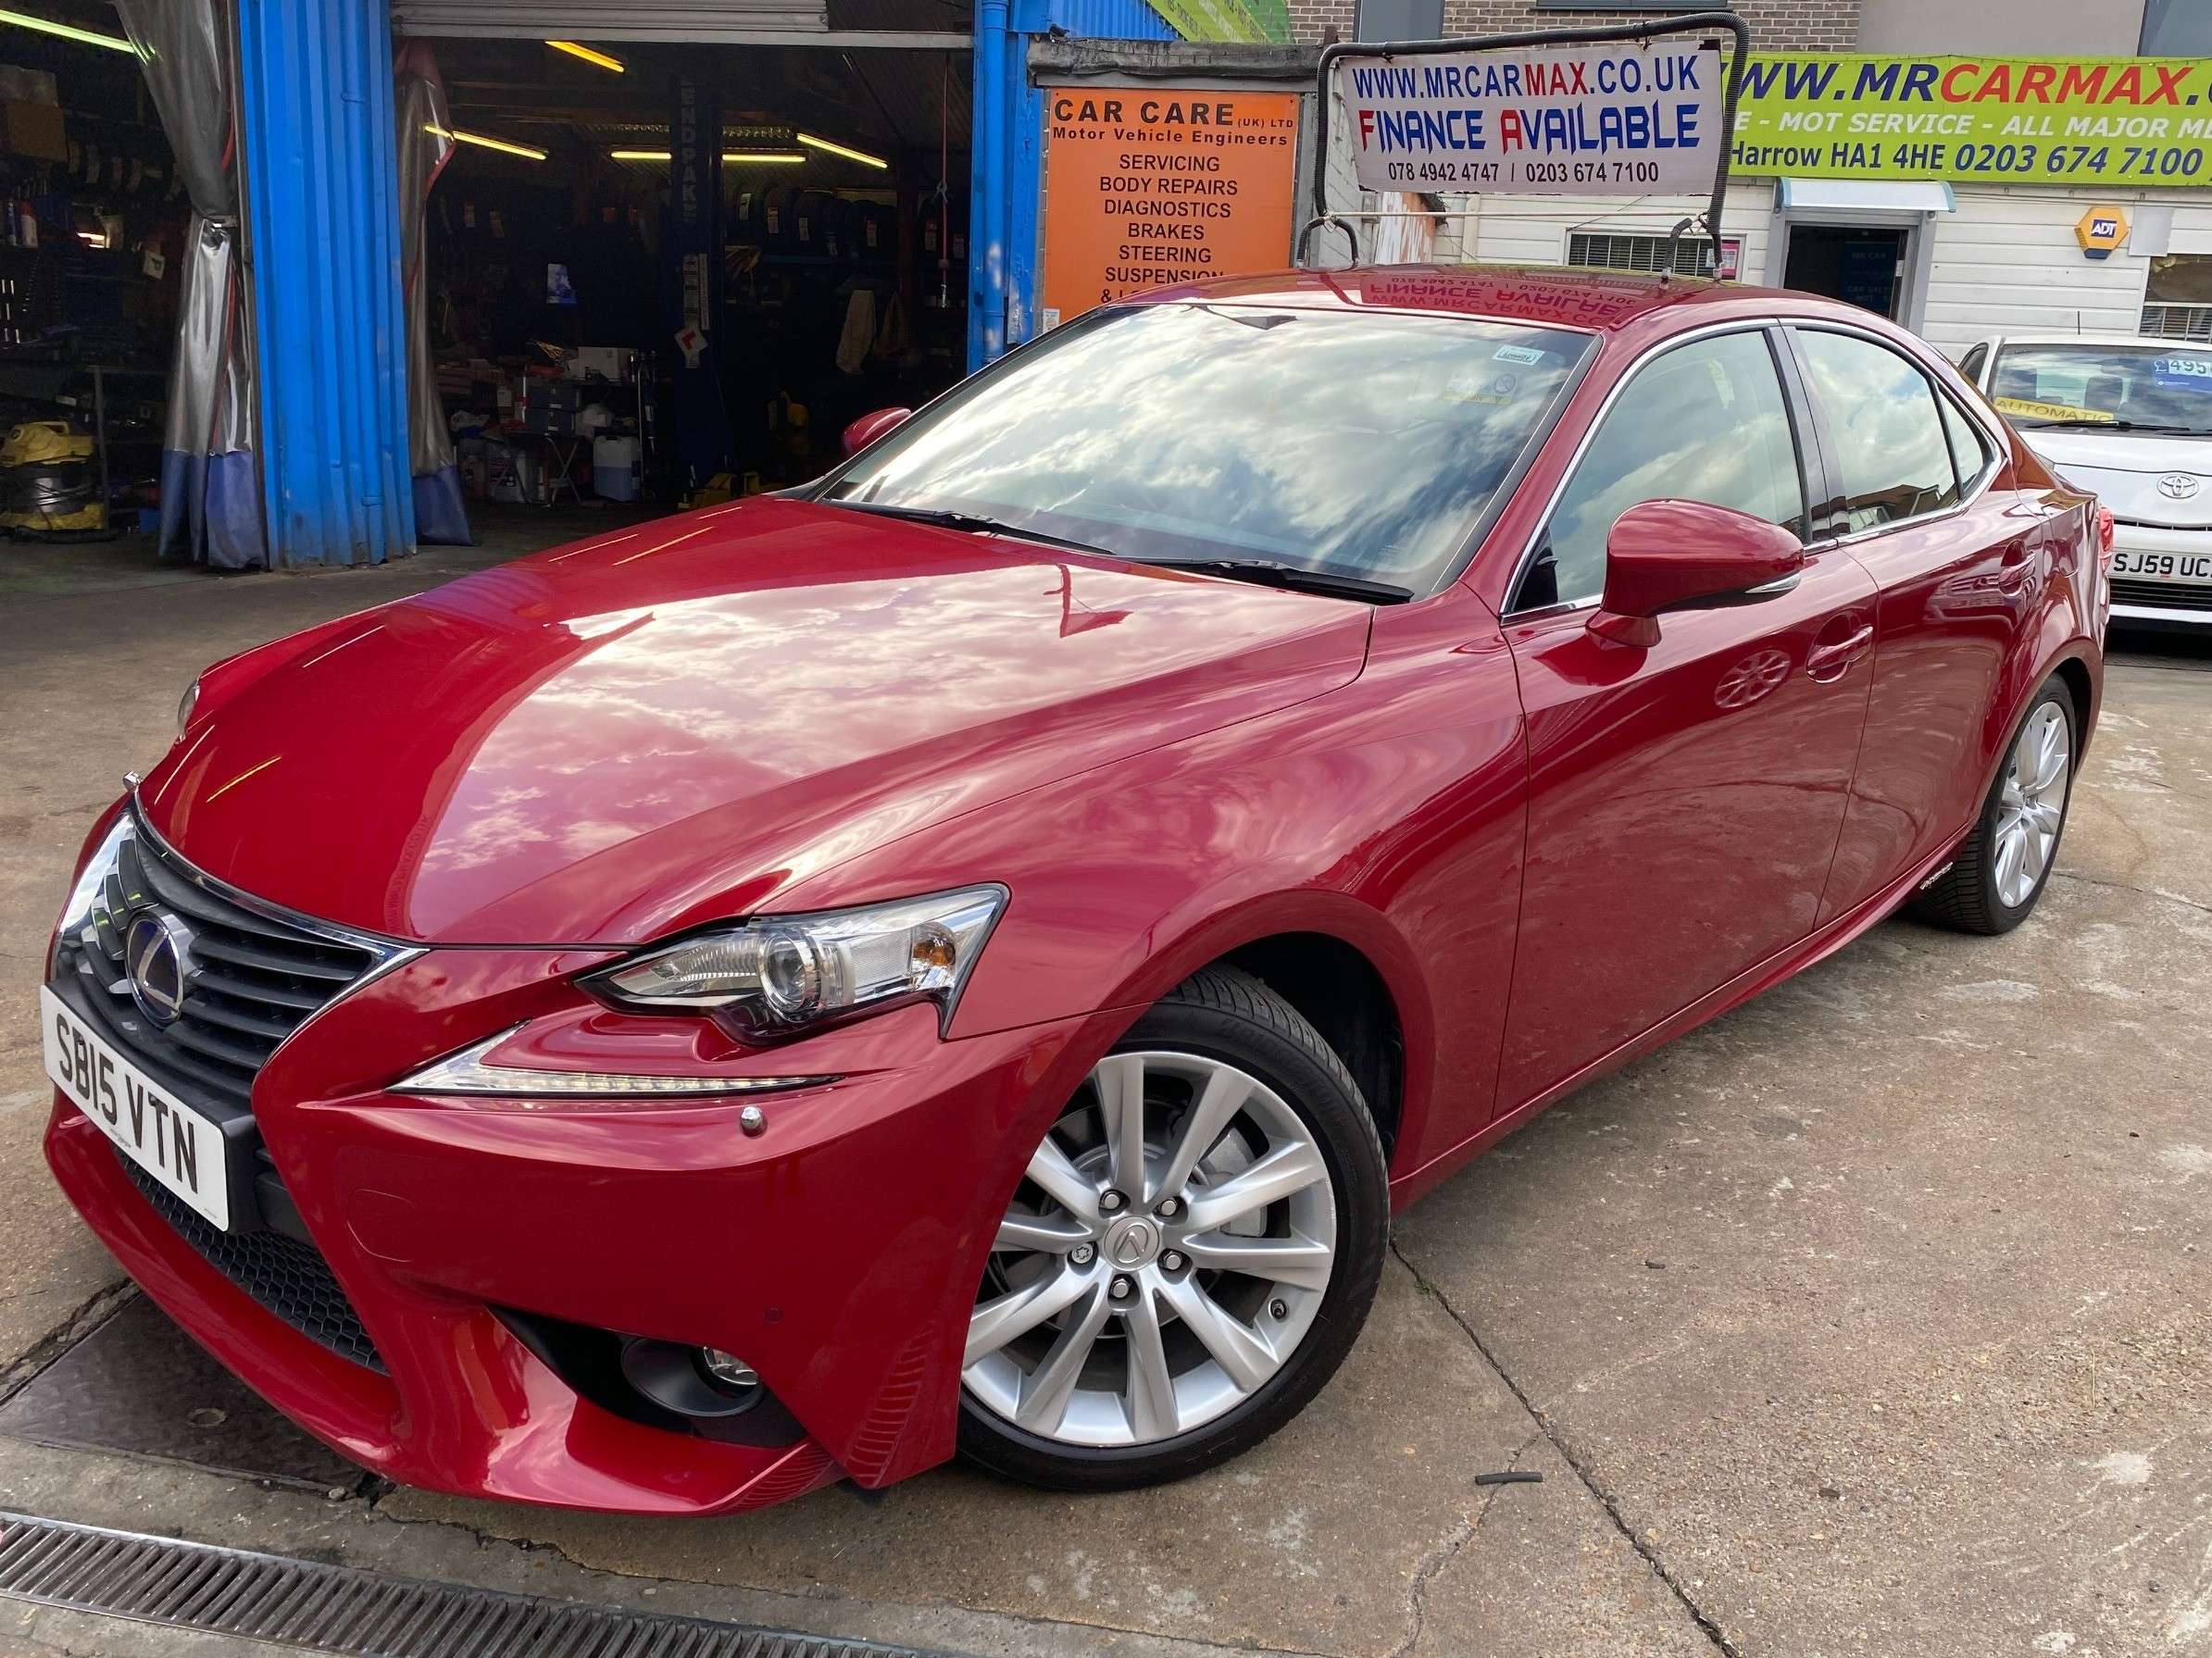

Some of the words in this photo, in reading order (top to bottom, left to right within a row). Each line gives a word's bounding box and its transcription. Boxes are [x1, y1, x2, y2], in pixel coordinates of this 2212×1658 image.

[1352, 56, 1700, 98] WWW.MRCARMAX.CO.UK
[1720, 62, 2212, 106] WW.MRCARMAX.
[1055, 99, 1122, 122] CAR
[1140, 101, 1234, 126] CARE
[1237, 118, 1265, 129] (UK)
[1270, 118, 1293, 128] LTD
[1358, 110, 1486, 155] FINANCE
[1501, 99, 1700, 156] AVAILABLE
[1778, 112, 1843, 131] MOT
[1848, 113, 1975, 135] SERVICE
[2000, 115, 2055, 136] ALL
[2064, 116, 2170, 138] MAJOR
[1053, 127, 1106, 140] Motor
[1114, 128, 1183, 143] Vehicle
[1192, 131, 1287, 146] Engineers
[1118, 154, 1219, 172] SERVICING
[1831, 143, 1881, 168] HA1
[1893, 143, 1945, 169] 4HE
[1955, 143, 2037, 172] 0203
[2046, 145, 2109, 173] 674
[2118, 147, 2203, 175] 7100
[1389, 162, 1415, 181] 078
[1419, 162, 1456, 181] 4942
[1462, 163, 1499, 181] 4747
[1526, 163, 1568, 182] 0203
[1574, 163, 1607, 182] 674
[1612, 162, 1659, 182] 7100
[1100, 176, 1152, 193] BODY
[1157, 179, 1238, 195] REPAIRS
[1105, 199, 1231, 218] DIAGNOSTICS
[1128, 222, 1205, 240] BRAKES
[2091, 219, 2118, 237] ADT
[1118, 244, 1211, 263] STEERING
[1996, 400, 2112, 421] AUTOMATIC
[2113, 553, 2174, 574] SJ59
[2180, 556, 2212, 578] UC
[56, 1013, 118, 1126] SB15
[125, 1073, 198, 1194] VTN
